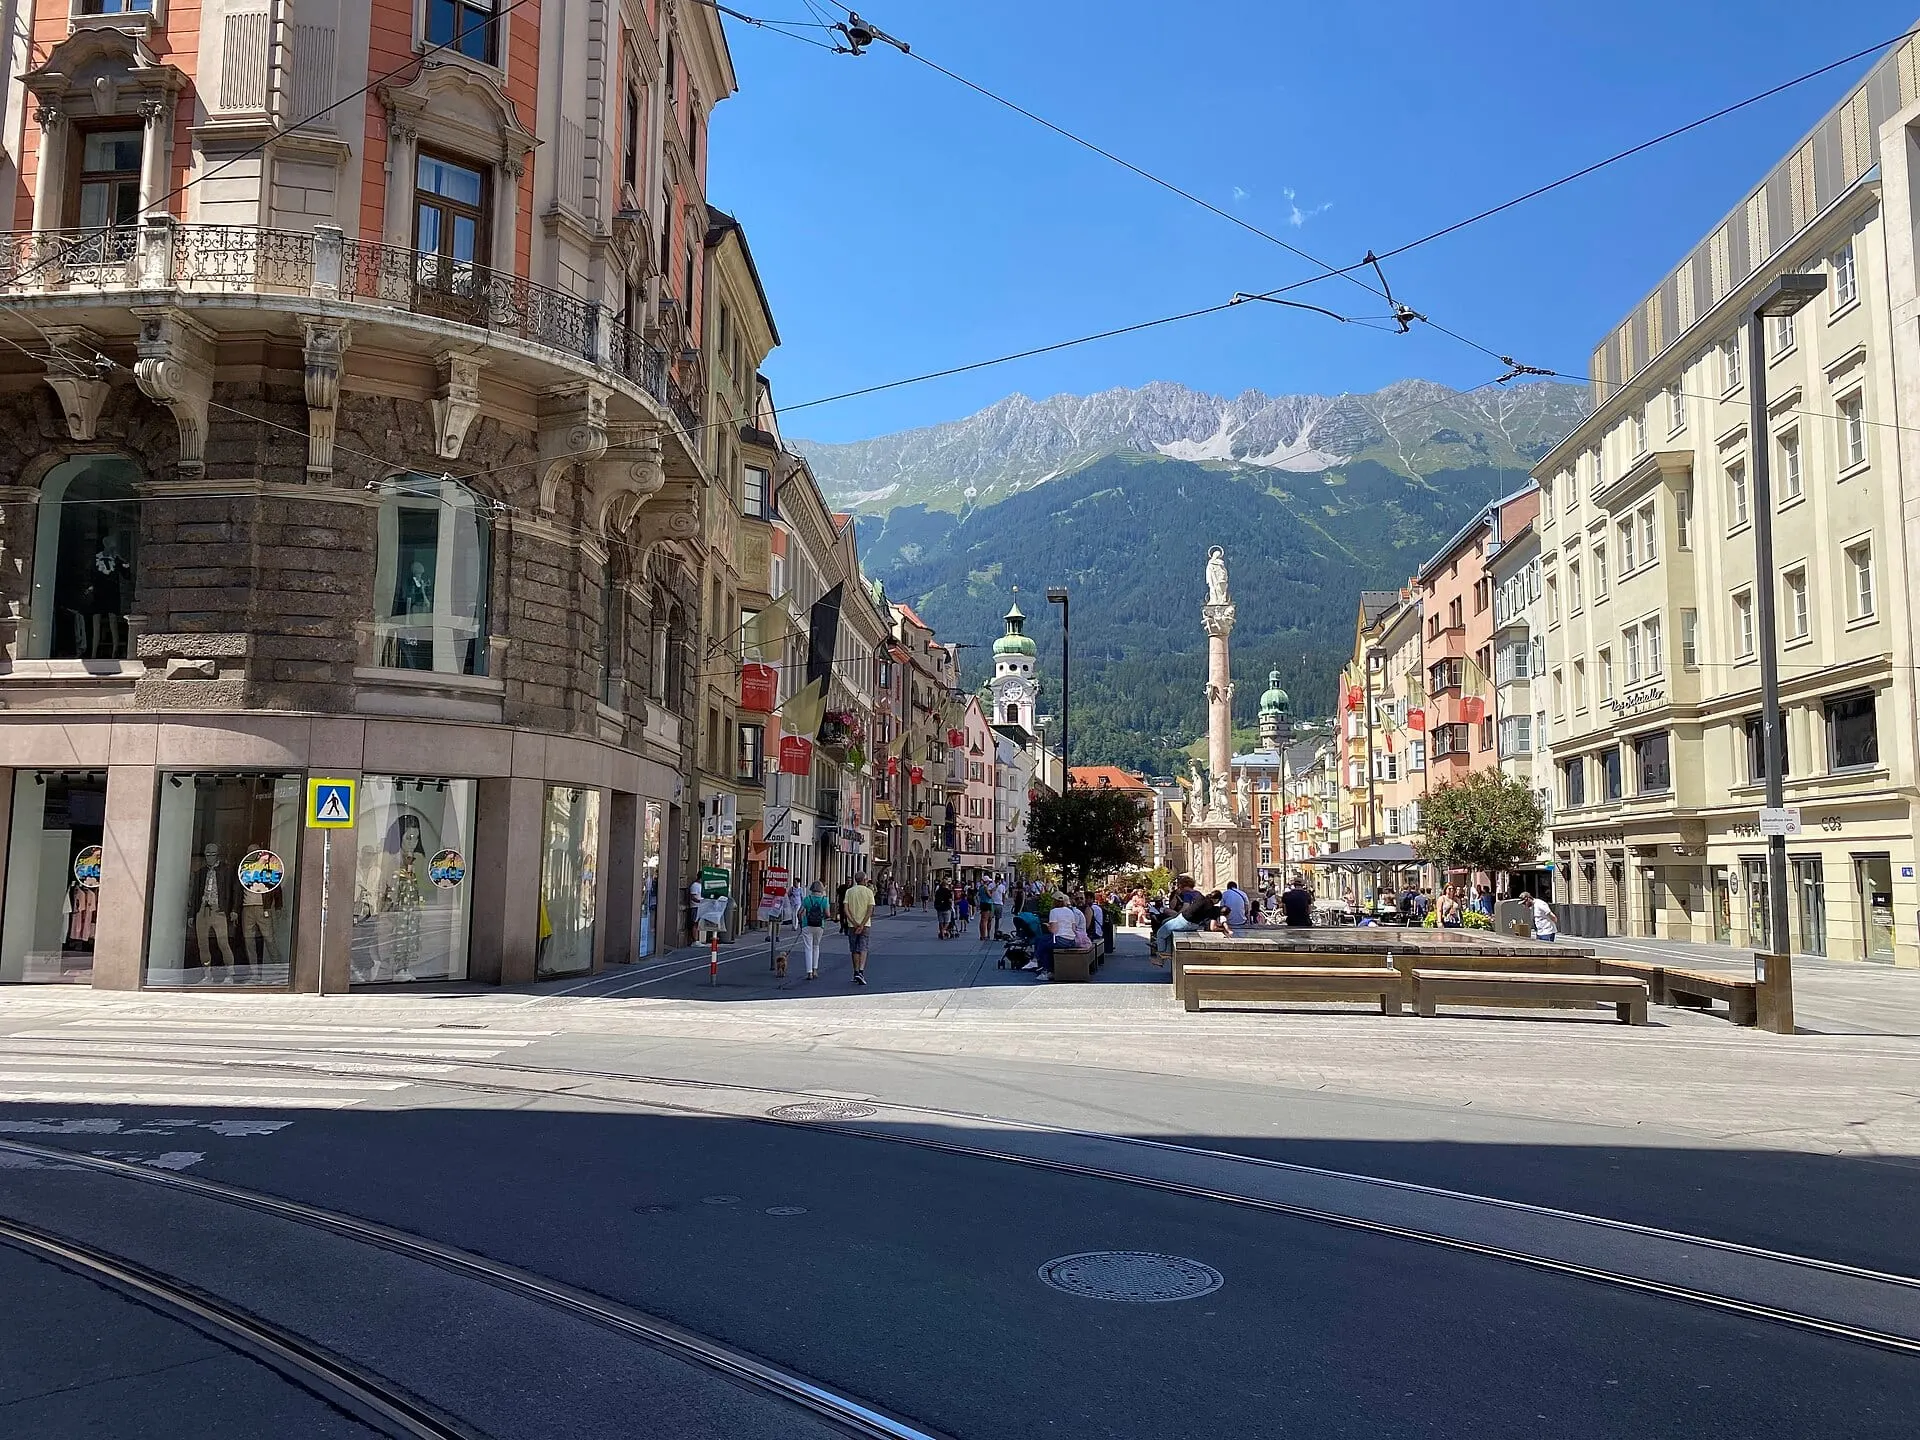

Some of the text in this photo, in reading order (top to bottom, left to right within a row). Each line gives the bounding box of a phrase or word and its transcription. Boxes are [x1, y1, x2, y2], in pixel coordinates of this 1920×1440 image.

[769, 813, 784, 828] 30
[1821, 816, 1842, 832] COS
[240, 870, 282, 884] SALE
[430, 868, 464, 880] SALE
[766, 870, 788, 879] Kronen
[765, 879, 788, 888] Zeitung
